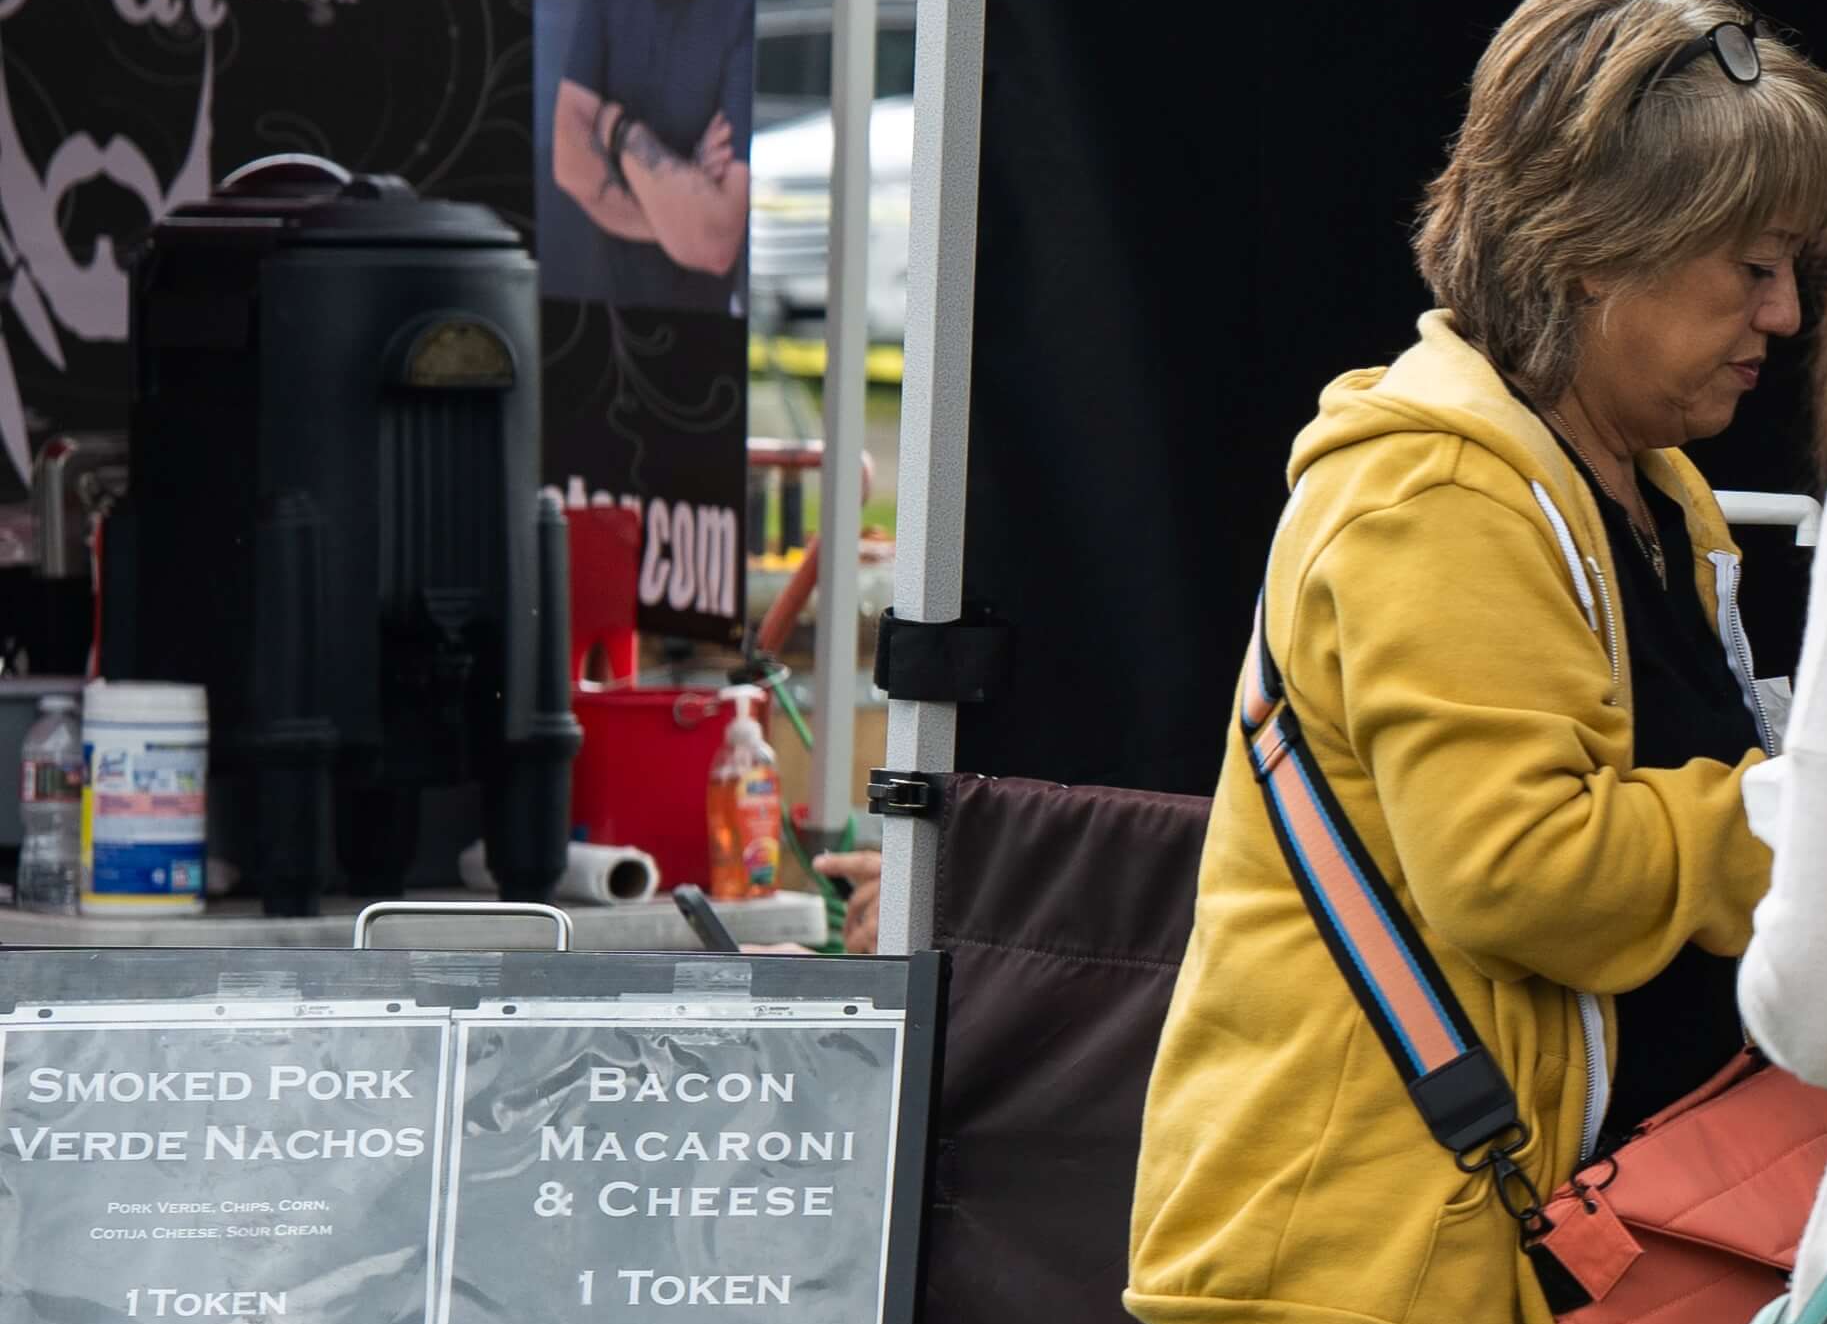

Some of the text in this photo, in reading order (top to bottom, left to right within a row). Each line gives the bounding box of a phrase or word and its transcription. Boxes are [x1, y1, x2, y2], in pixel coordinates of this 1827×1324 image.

[27, 1065, 416, 1103] SMOKED PORK
[588, 1066, 795, 1103] BACON
[8, 1125, 426, 1162] VERDE NACHOS
[539, 1125, 855, 1162] MACARONI
[533, 1180, 834, 1217] & CHEESE
[578, 1269, 792, 1306] 1 TOKEN
